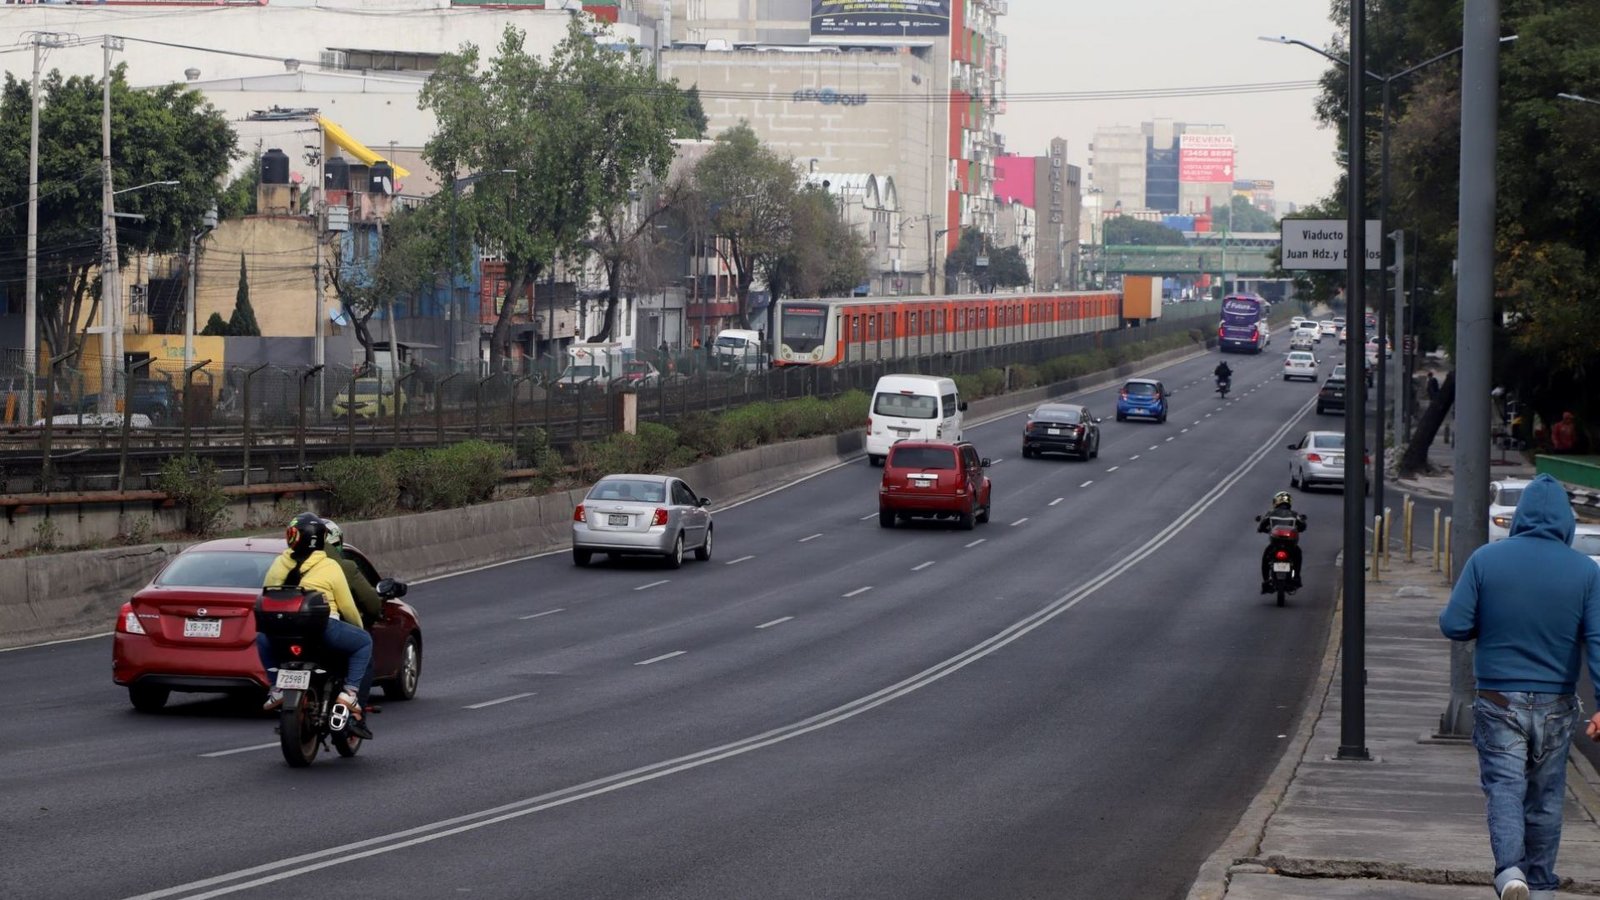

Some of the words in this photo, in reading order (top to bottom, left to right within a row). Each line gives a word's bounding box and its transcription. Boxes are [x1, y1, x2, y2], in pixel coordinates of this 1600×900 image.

[1302, 229, 1344, 240] Viaducto
[1287, 248, 1308, 259] Juan
[279, 674, 306, 684] 725981
